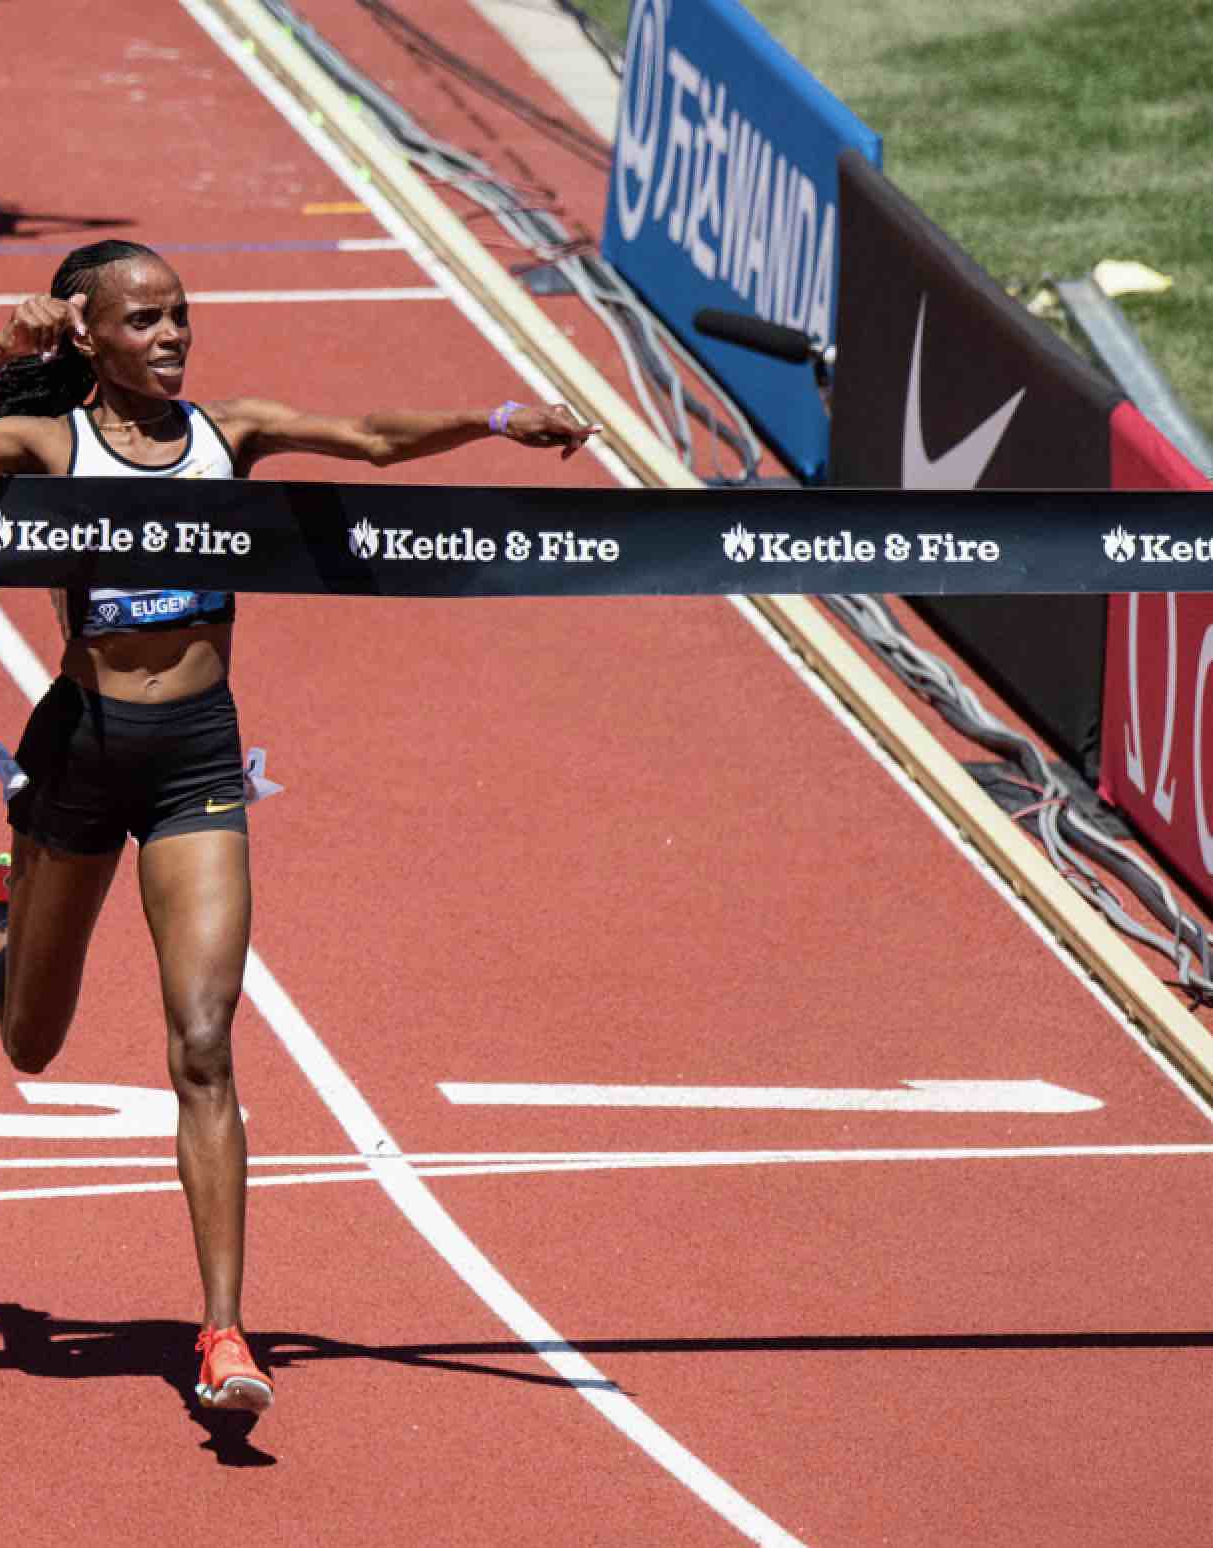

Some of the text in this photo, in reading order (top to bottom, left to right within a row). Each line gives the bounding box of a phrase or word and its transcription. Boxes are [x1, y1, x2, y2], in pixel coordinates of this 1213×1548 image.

[719, 108, 836, 352] WANDA
[17, 517, 252, 555] Kettle & Fire
[383, 527, 620, 562] Kettle & Fire
[759, 530, 1000, 562] Kettle & Fire
[1138, 535, 1213, 562] Ket
